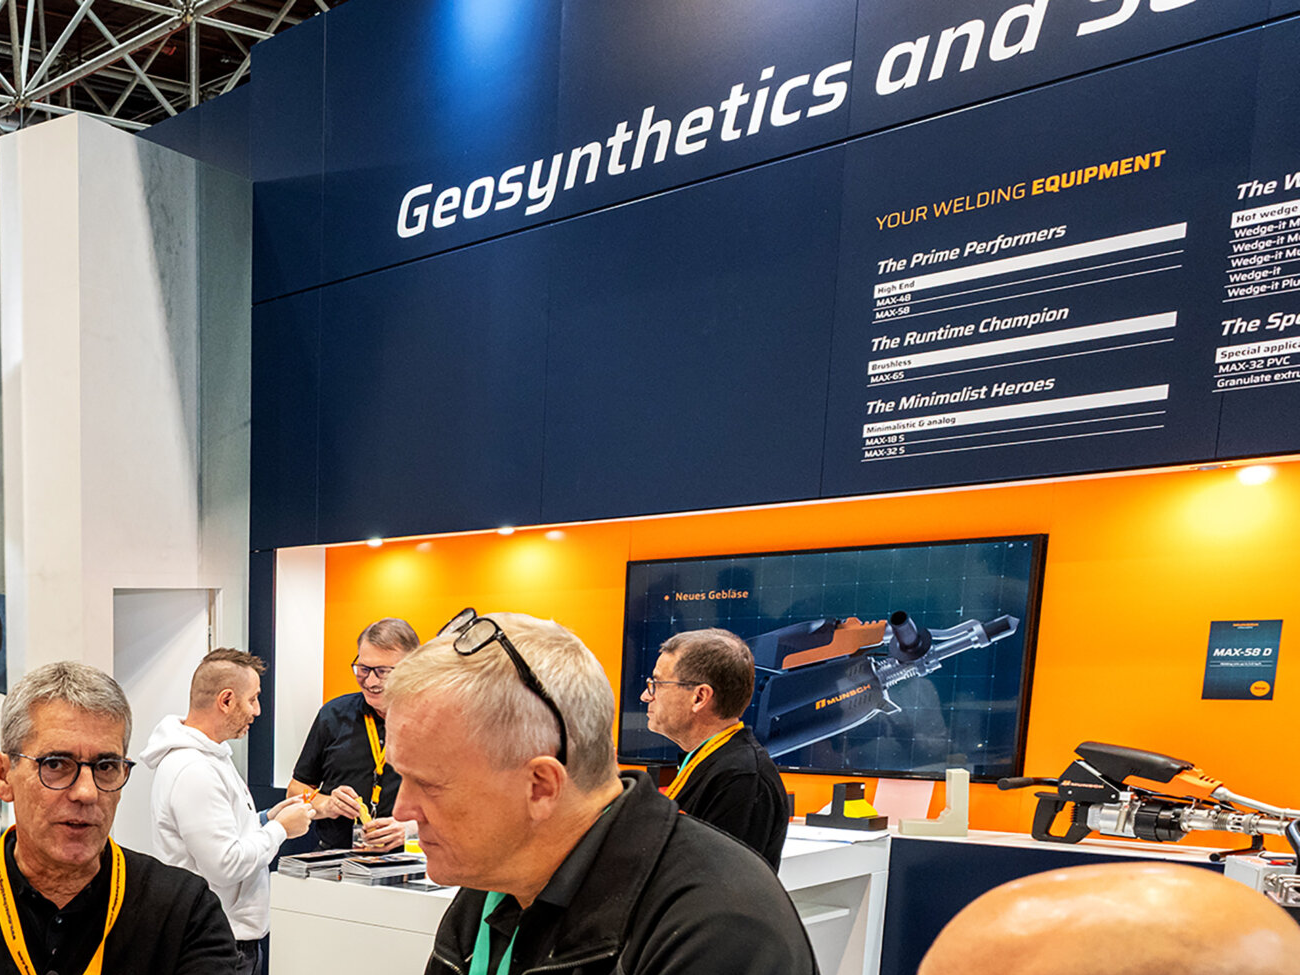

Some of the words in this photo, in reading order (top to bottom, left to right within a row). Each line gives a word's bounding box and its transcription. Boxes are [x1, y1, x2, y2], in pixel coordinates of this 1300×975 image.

[396, 60, 853, 239] Geosynthetics
[875, 0, 1049, 96] and
[876, 205, 928, 231] YOUR
[933, 182, 1026, 218] WELDING
[1031, 149, 1166, 196] EQUIPMENT
[1237, 179, 1278, 200] The
[1236, 212, 1257, 223] Hot
[1259, 205, 1298, 220] wedge
[1234, 220, 1287, 239] Wedge-it
[877, 259, 907, 276] The
[910, 246, 960, 270] Prime
[963, 224, 1067, 258] Performers
[1233, 236, 1286, 253] Wedge-it
[1231, 250, 1284, 268] Wedge-it
[1229, 265, 1282, 283] Wedge-it
[899, 280, 915, 290] End
[1227, 280, 1280, 298] Wedge-it
[871, 335, 901, 352] The
[903, 322, 976, 347] Runtime
[978, 305, 1070, 335] Champion
[1221, 317, 1261, 337] The
[1220, 346, 1261, 360] Special
[871, 359, 912, 371] Brushless
[1219, 359, 1264, 373] MAX-32
[1266, 355, 1291, 368] PVC
[1217, 373, 1272, 388] Granulate
[866, 399, 896, 414] The
[898, 384, 988, 411] Minimalist
[990, 378, 1056, 398] Heroes
[866, 420, 916, 434] Minimalistic
[927, 416, 956, 427] analog
[865, 435, 898, 446] MAX-18
[864, 447, 898, 458] MAX-32
[675, 591, 706, 602] Neues
[708, 589, 749, 600] Gebläse
[1213, 648, 1261, 657] MAX-58
[1262, 648, 1273, 657] D
[826, 684, 872, 706] MUNSCH
